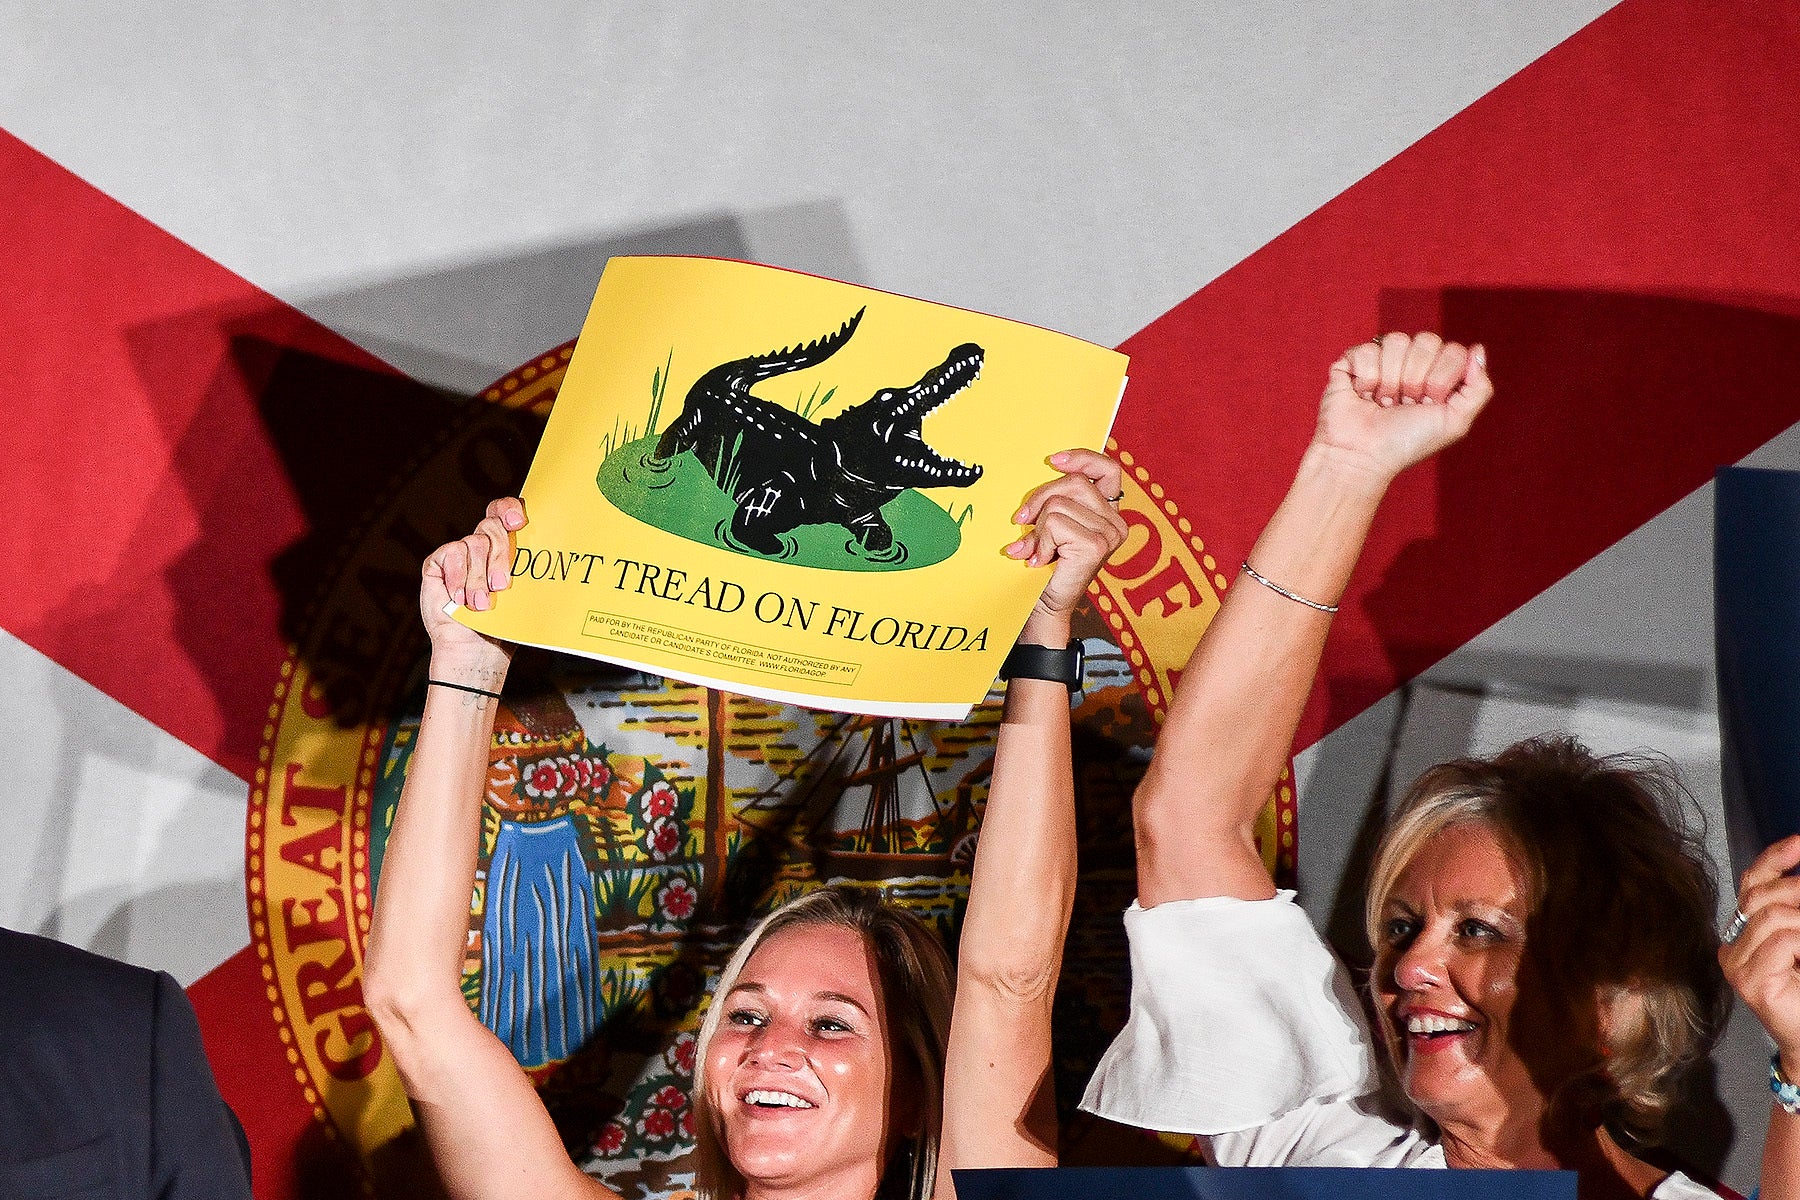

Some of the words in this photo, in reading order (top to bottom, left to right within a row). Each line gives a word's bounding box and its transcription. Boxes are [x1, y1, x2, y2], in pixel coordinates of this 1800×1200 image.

[510, 547, 604, 584] DON'T
[613, 558, 746, 613] TREAD
[754, 591, 821, 631] ON
[822, 606, 990, 652] FLORIDA
[1104, 508, 1203, 618] OF
[590, 615, 605, 624] PAID
[605, 618, 620, 627] FOR
[621, 620, 631, 629] BY
[632, 623, 646, 632] THE
[647, 626, 694, 643] REPUBLICAN
[695, 637, 720, 649] PARTY
[720, 643, 731, 651] OF
[766, 653, 782, 661] NOT
[783, 656, 829, 670] AUTHORIZED
[609, 628, 649, 642] CANDIDATE
[650, 637, 661, 645] OR
[663, 639, 712, 656] CANDIDATE'S
[280, 763, 383, 1082] GREAT
